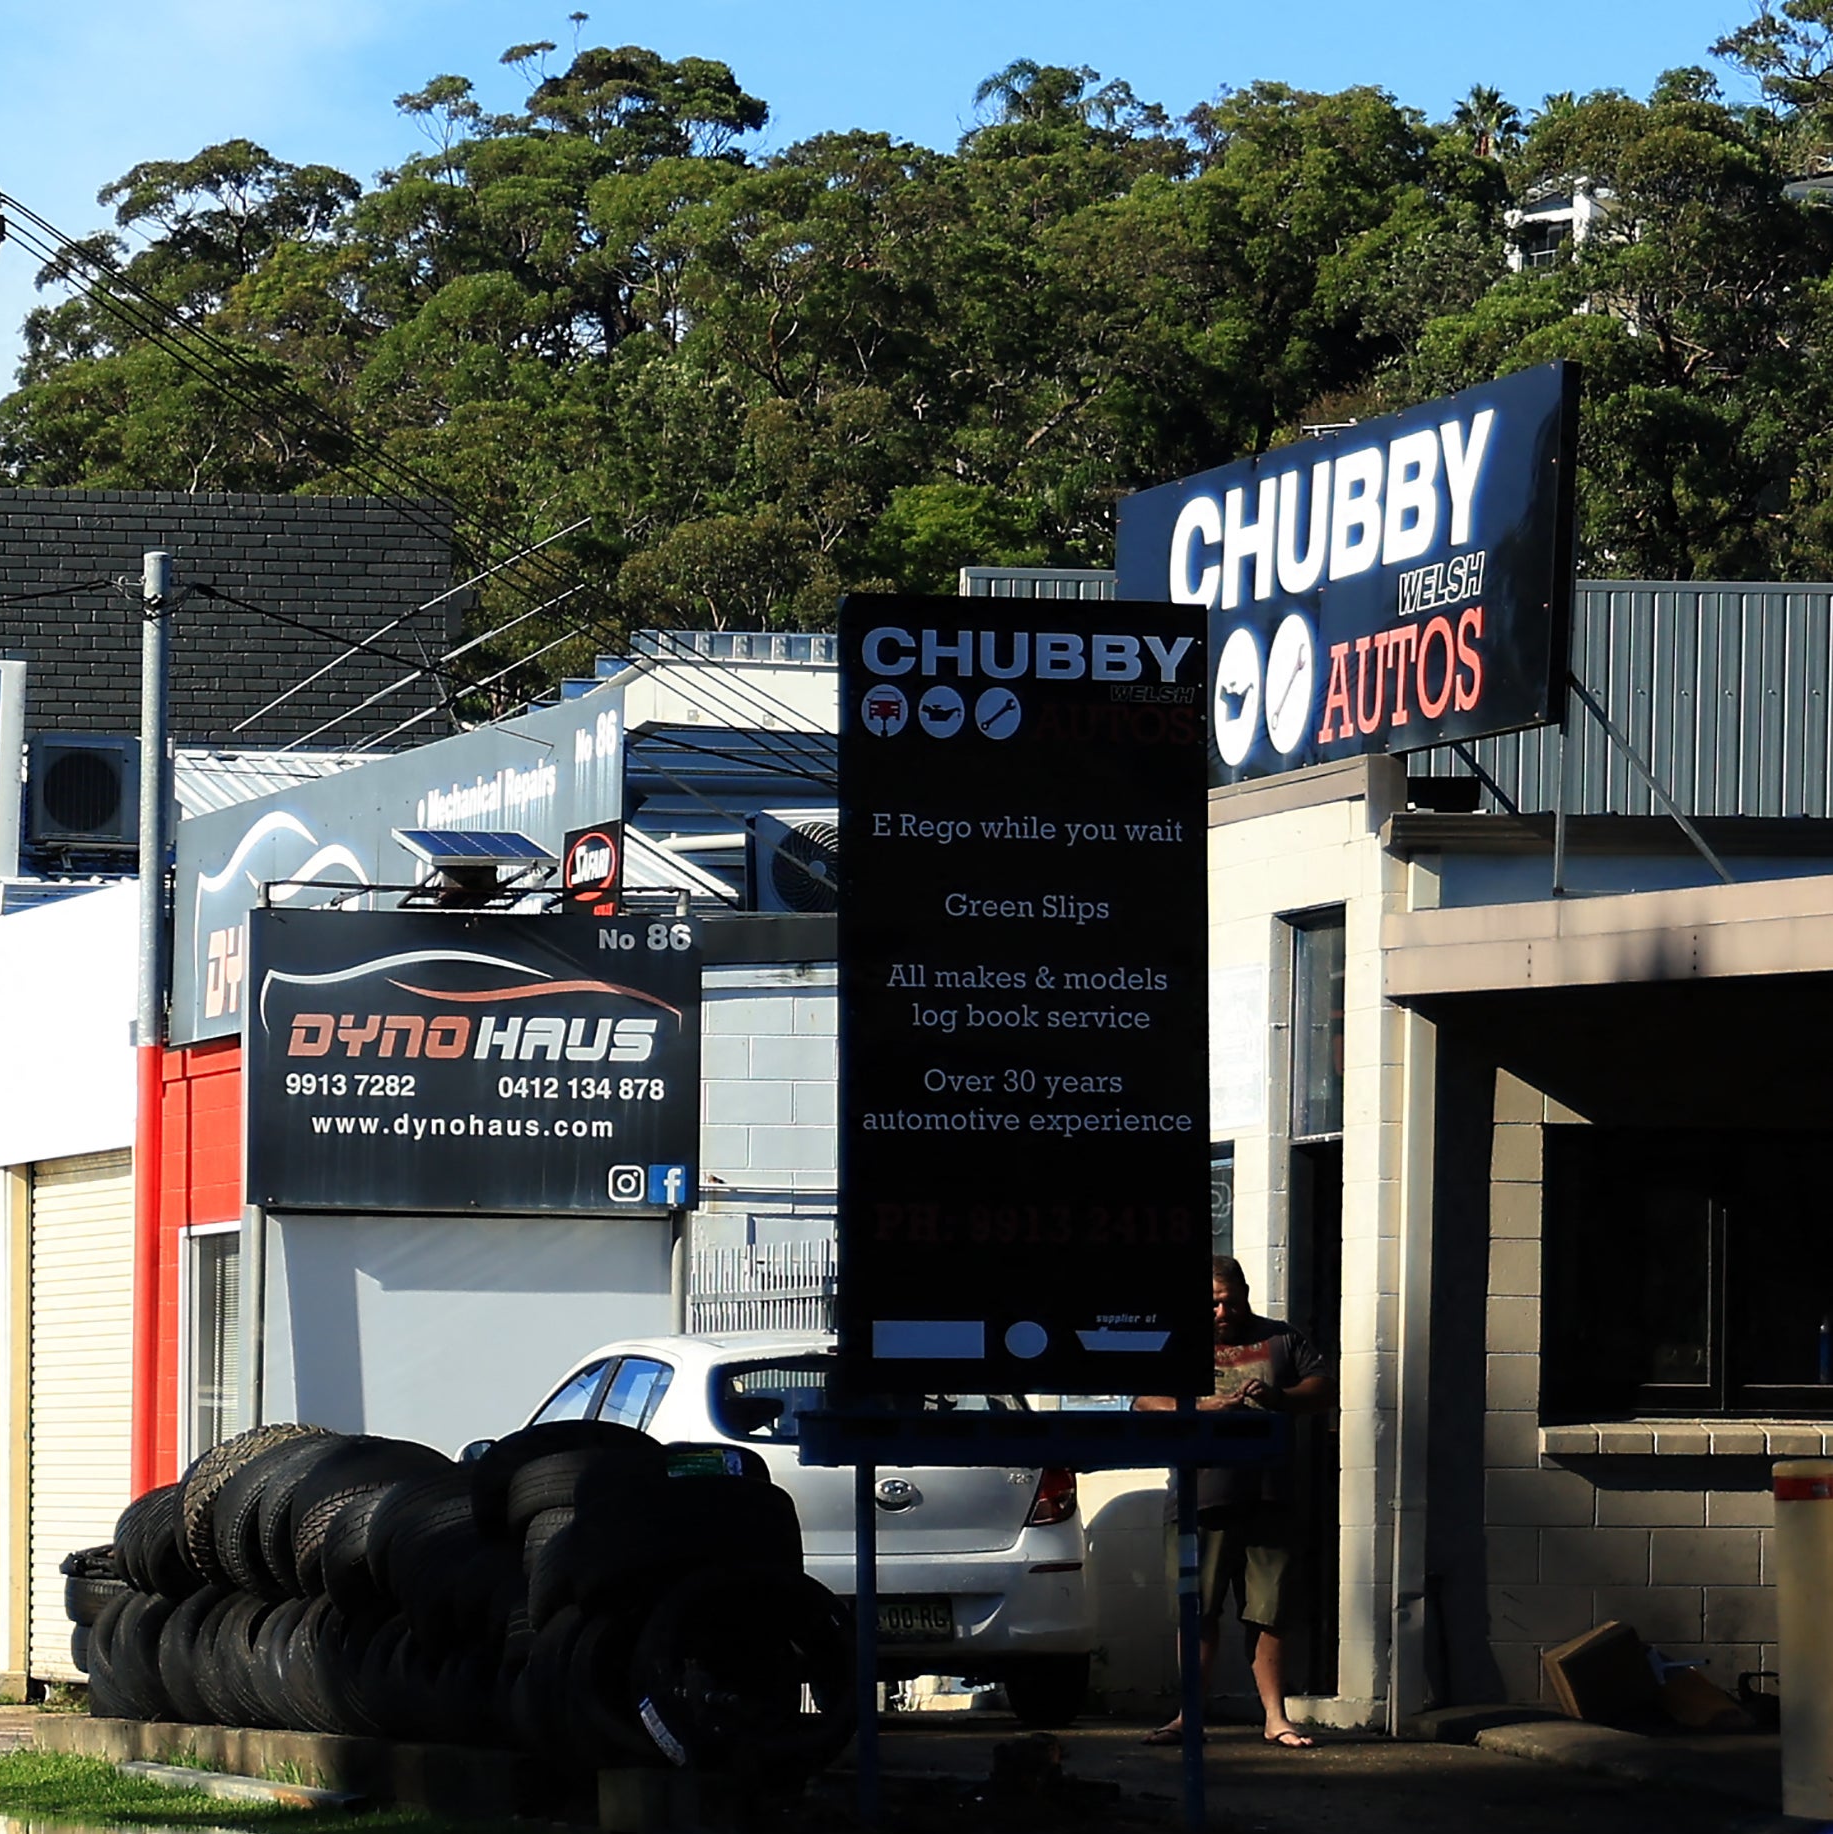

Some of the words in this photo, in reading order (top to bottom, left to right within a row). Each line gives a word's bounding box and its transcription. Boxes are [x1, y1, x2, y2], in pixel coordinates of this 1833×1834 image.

[1170, 409, 1494, 610] CHUBBY
[1399, 551, 1485, 616] WELSH
[861, 626, 1195, 683] CHUBBY
[1318, 607, 1483, 744] AUTOS
[1110, 685, 1196, 704] WELSH
[575, 728, 593, 764] No
[596, 709, 618, 758] 86
[1032, 704, 1196, 746] AUTOS
[427, 770, 502, 829] Mechanical
[504, 758, 557, 813] Repairs
[872, 813, 891, 836] E
[899, 814, 972, 844] Rego
[980, 816, 1057, 841] while
[1065, 823, 1117, 847] you
[1124, 818, 1184, 843] wait
[571, 844, 610, 885] SAFARI
[944, 892, 1034, 918] Green
[1042, 894, 1110, 925] Slips
[598, 929, 635, 950] No
[647, 923, 692, 951] 86
[886, 964, 926, 988] All
[934, 965, 1027, 989] makes
[1035, 966, 1056, 990] &
[1063, 968, 1168, 991] models
[911, 1003, 958, 1034] log
[966, 1004, 1040, 1028] book
[1046, 1006, 1151, 1029] service
[285, 1073, 348, 1096] 9913
[354, 1074, 416, 1097] 7282
[497, 1077, 559, 1100] 0412
[567, 1078, 611, 1100] 134
[618, 1078, 665, 1101] 878
[924, 1068, 995, 1093] Over
[1003, 1069, 1036, 1093] 30
[1044, 1074, 1123, 1099] years
[311, 1114, 614, 1142] www.dynohaus.com
[862, 1108, 1021, 1131] automotive
[1029, 1108, 1193, 1137] experience
[1096, 1313, 1141, 1324] supplier
[1145, 1313, 1158, 1324] of
